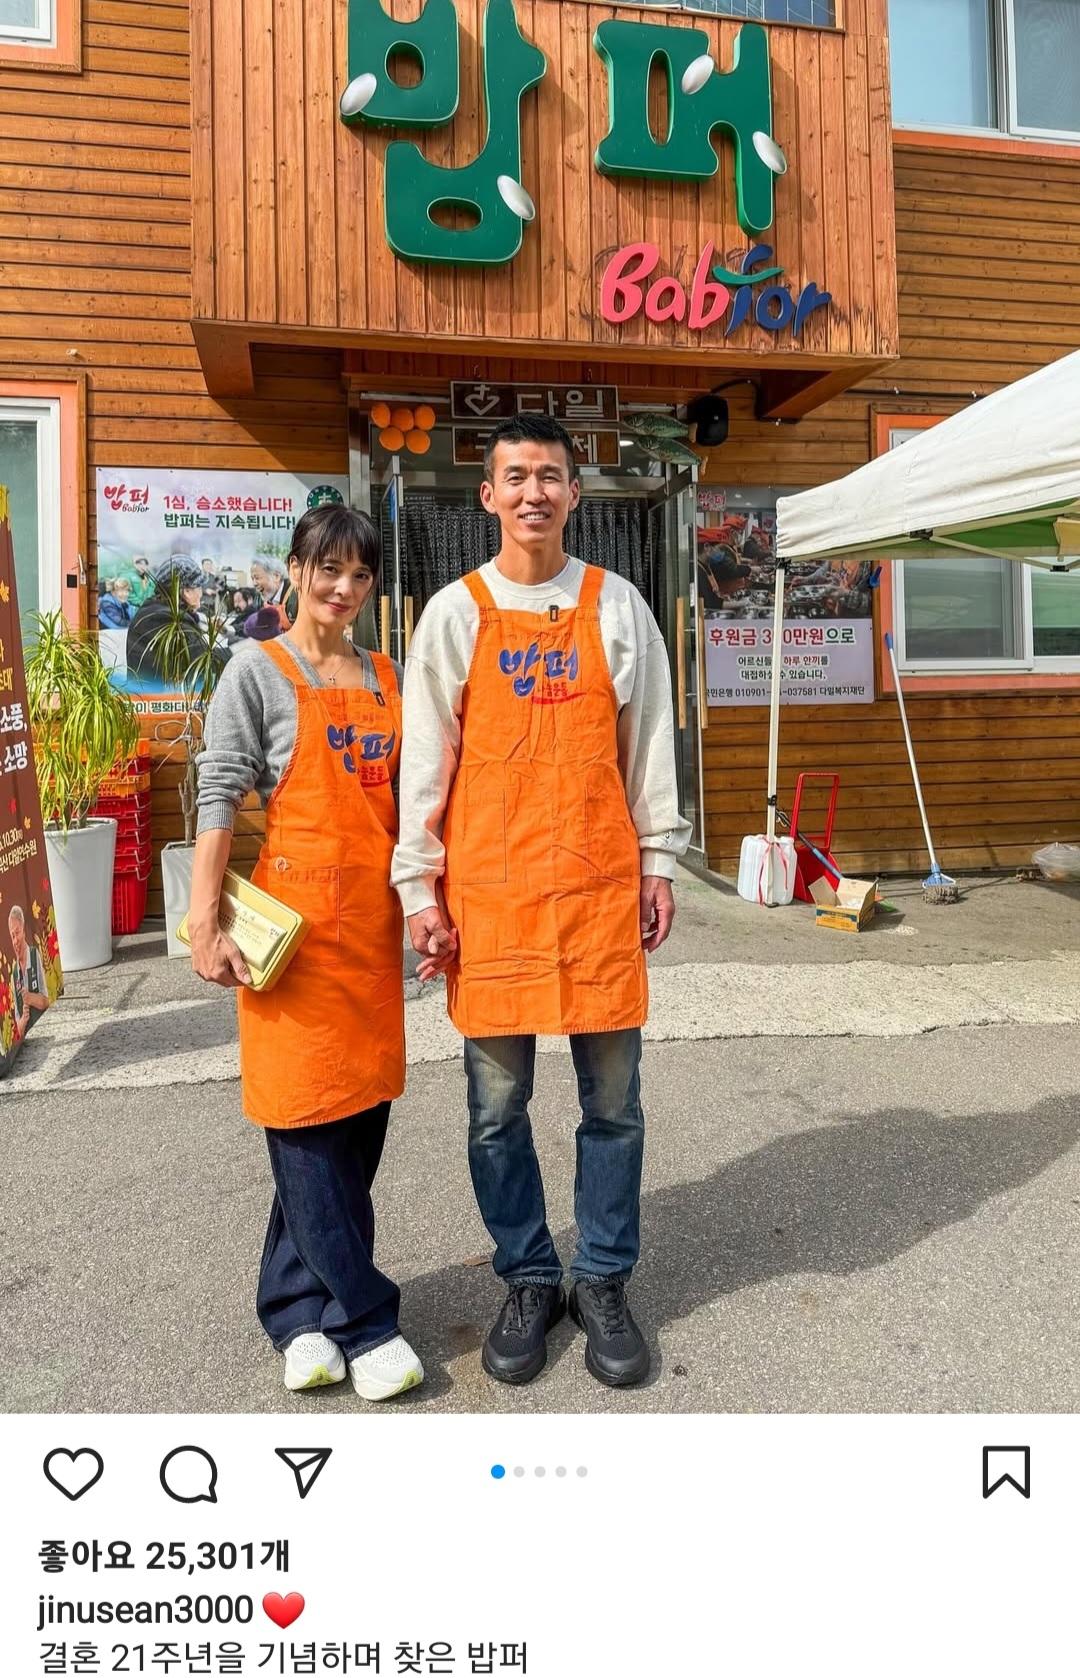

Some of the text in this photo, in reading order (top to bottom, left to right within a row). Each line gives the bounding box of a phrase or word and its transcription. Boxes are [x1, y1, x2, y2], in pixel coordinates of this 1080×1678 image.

[340, 0, 787, 266] 밥퍼
[516, 389, 604, 418] 다일
[104, 484, 149, 511] 밥퍼
[163, 496, 191, 512] 1심,
[196, 496, 293, 513] 승소했습니다!
[164, 513, 296, 530] 밥퍼는 지속됩니다!
[709, 628, 855, 646] 후원금 30만원으로
[499, 640, 578, 697] 밥퍼
[784, 655, 801, 667] 하루
[789, 669, 826, 681] 있습니다.
[735, 686, 817, 698] 010901--037581
[0, 702, 27, 733] 소풍,
[4, 740, 28, 773] 소망
[327, 725, 396, 774] 밥퍼
